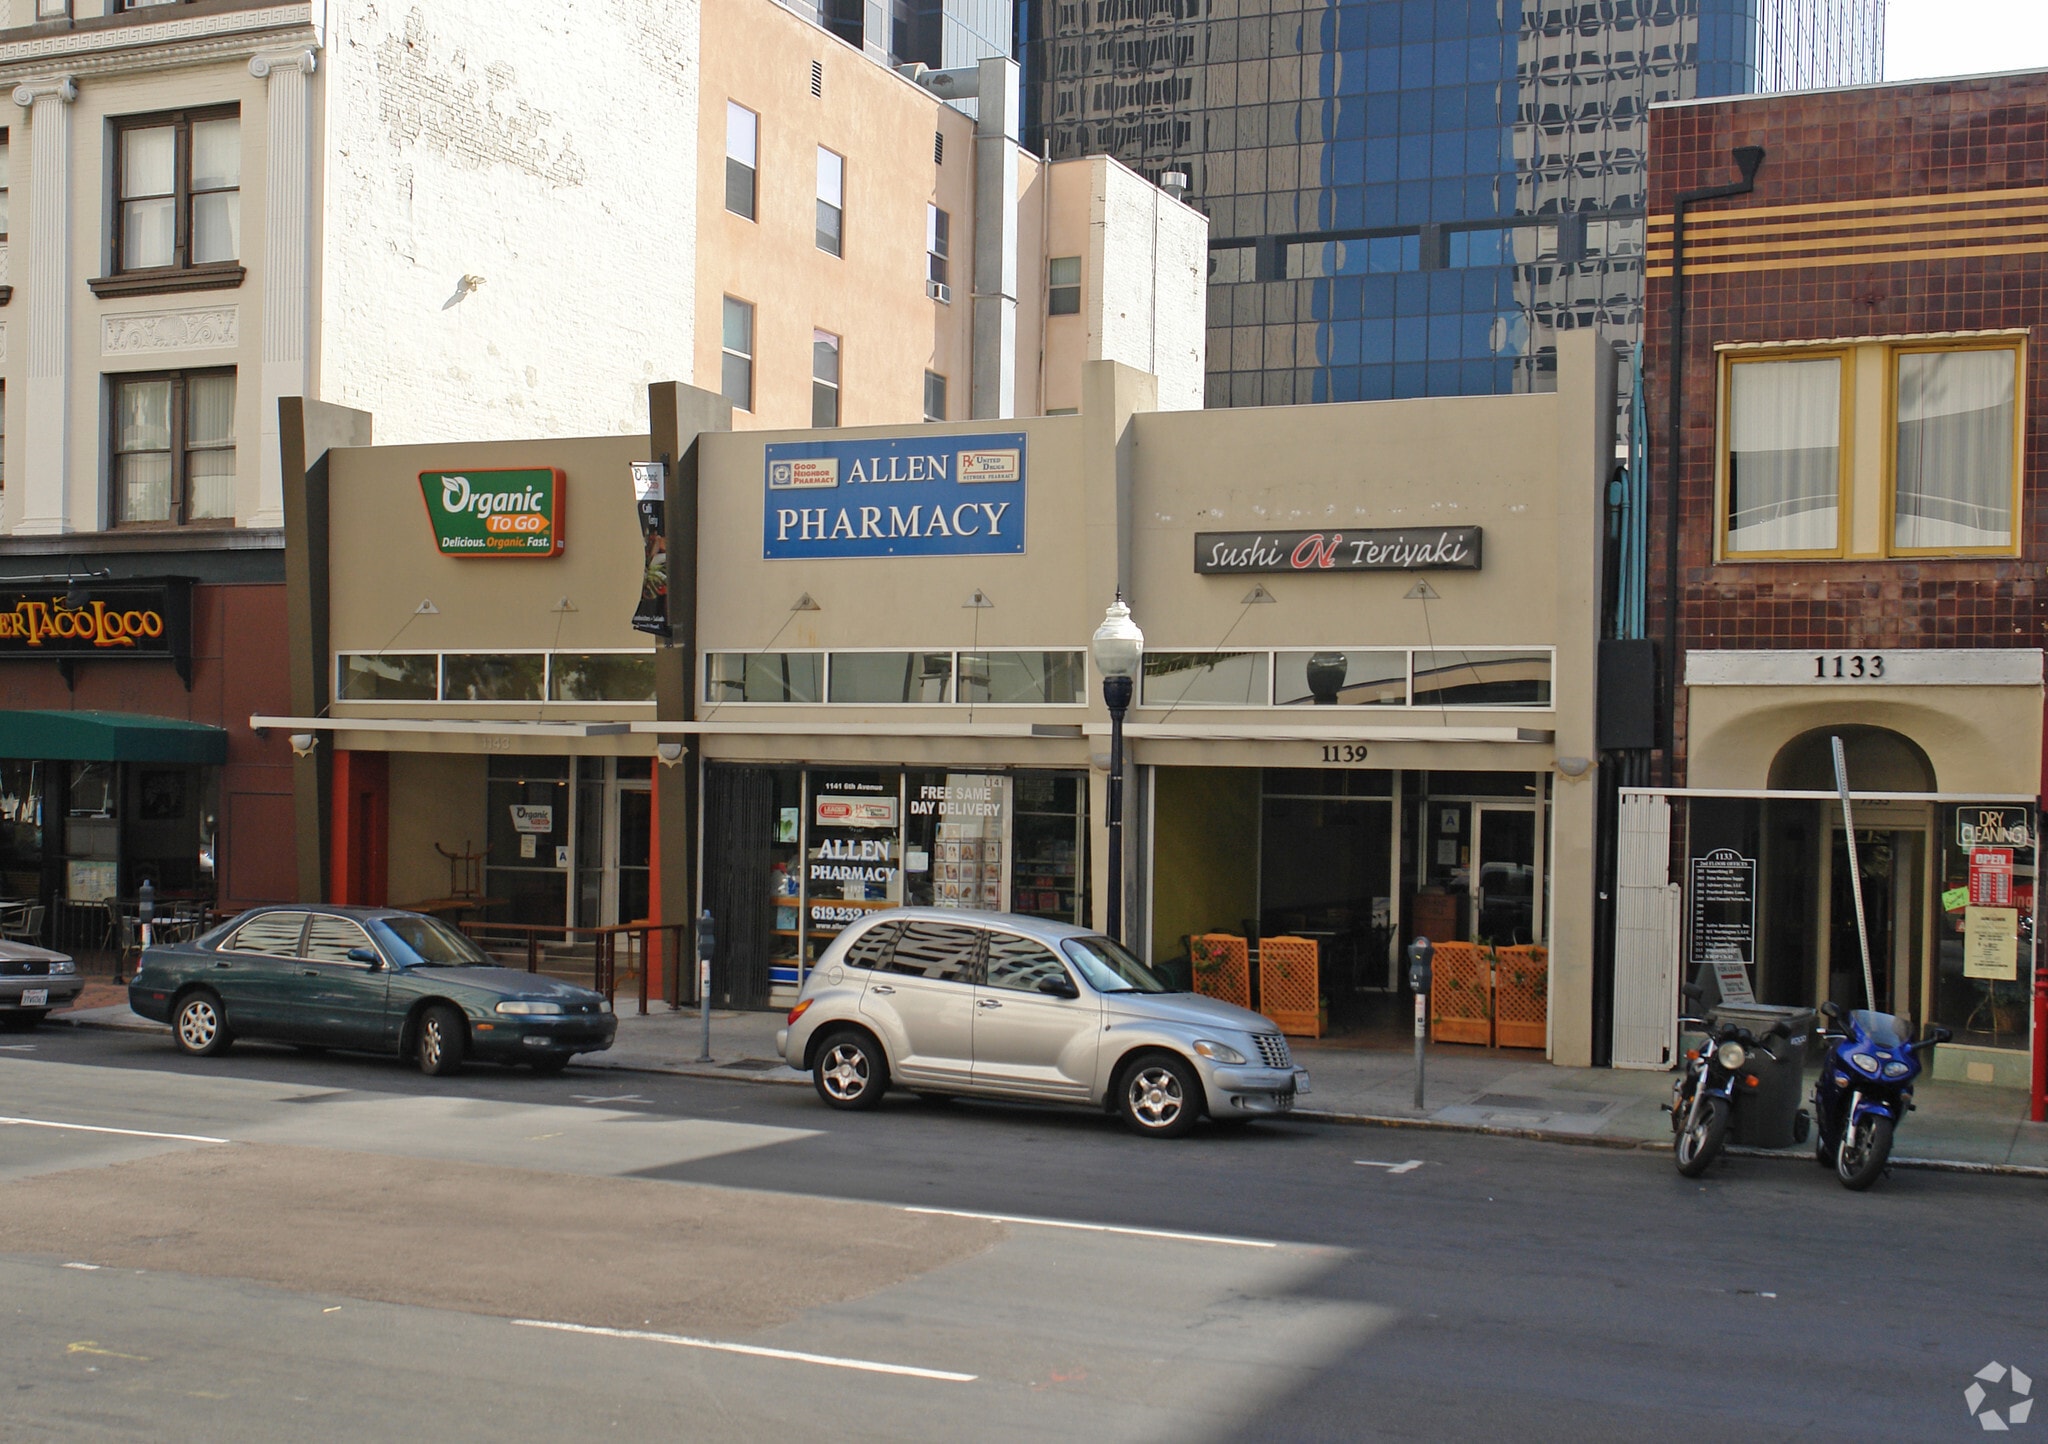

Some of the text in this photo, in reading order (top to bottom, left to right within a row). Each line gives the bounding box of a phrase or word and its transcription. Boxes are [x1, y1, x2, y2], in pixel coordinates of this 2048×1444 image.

[846, 454, 950, 484] ALLEN
[793, 477, 835, 485] PHARMACY
[441, 475, 544, 519] Organic
[776, 502, 1011, 542] PHARMACY
[441, 536, 550, 550] Delicious. Organic. Fast.
[1206, 535, 1284, 567] Sushi
[1350, 531, 1469, 568] Teriyaki
[1814, 655, 1886, 678] 1133
[1322, 744, 1368, 762] 1139
[825, 782, 842, 790] 1141
[857, 783, 884, 791] Avenue
[920, 785, 992, 801] FREE SAME
[516, 806, 549, 821] Organic
[910, 801, 1001, 817] DAY DELIVERY
[1979, 810, 2005, 828] DRY
[1961, 826, 2026, 844] CLEANING
[559, 851, 568, 862] A
[817, 838, 891, 862] ALLEN
[1715, 852, 1733, 860] 1133
[1974, 853, 2007, 865] OPEN
[810, 864, 897, 882] PHARMACY
